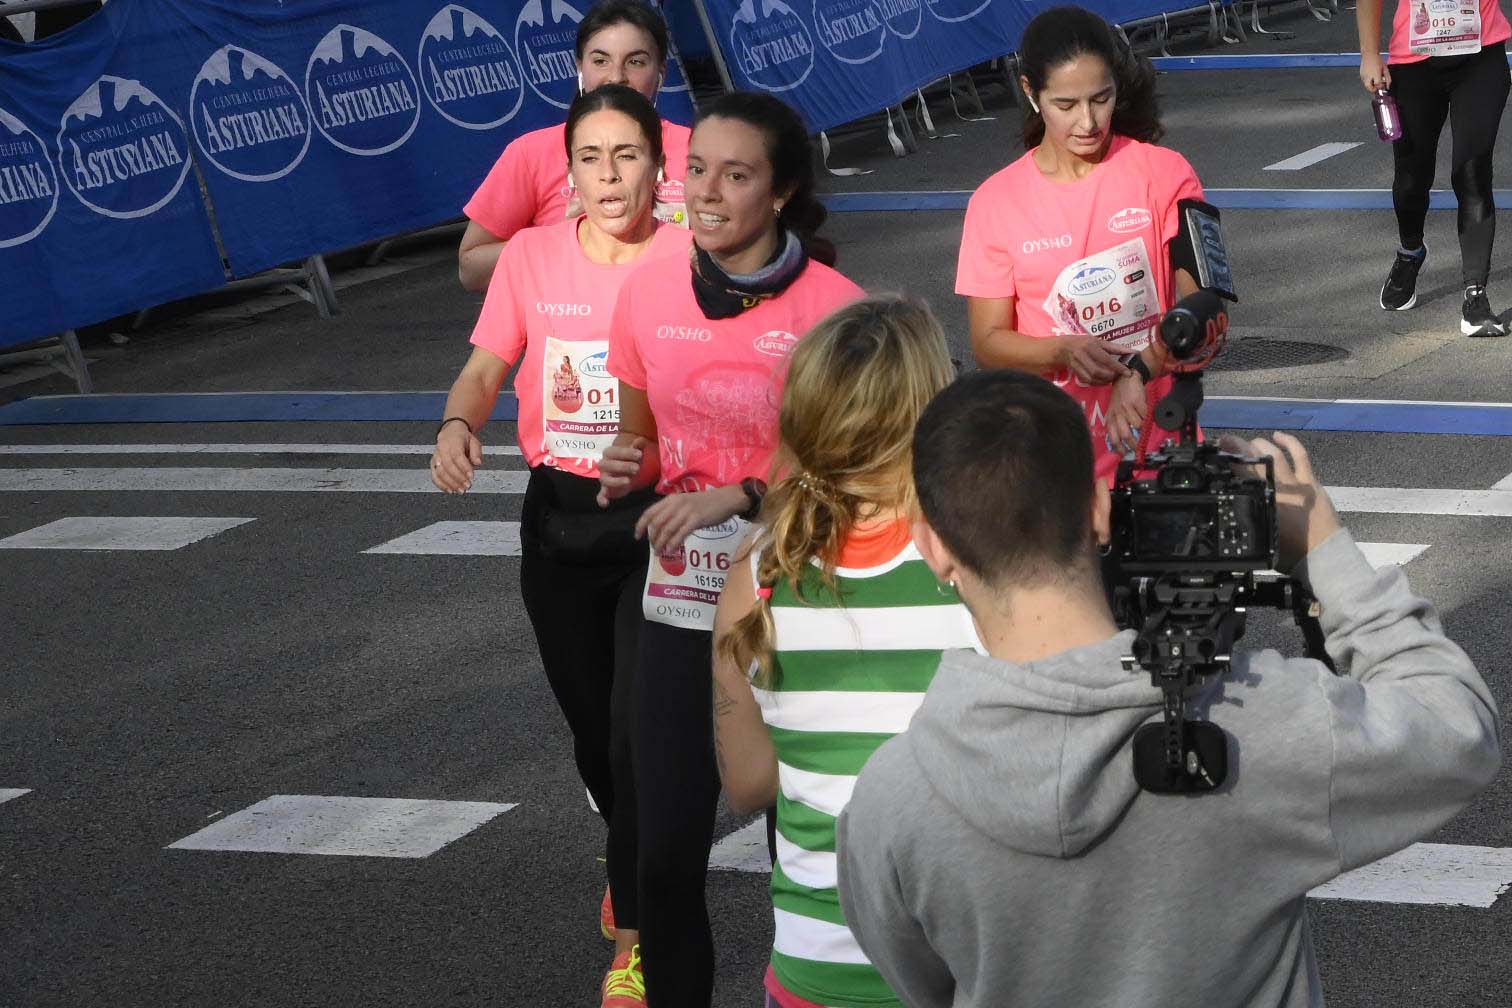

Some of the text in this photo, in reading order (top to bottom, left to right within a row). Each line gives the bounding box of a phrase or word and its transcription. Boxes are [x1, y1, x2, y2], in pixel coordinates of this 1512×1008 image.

[1432, 17, 1456, 28] 016
[428, 55, 520, 104] ASTURIANA
[315, 79, 416, 129] ASTURIANA
[202, 101, 306, 154] ASTURIANA
[1023, 235, 1073, 254] OYSHO
[1072, 273, 1113, 293] ASTURIANA
[536, 301, 592, 317] OYSHO
[1082, 297, 1122, 321] 016
[656, 325, 712, 342] OYSHO
[1091, 318, 1115, 334] 6670
[587, 388, 616, 405] 01
[559, 423, 594, 432] CARRERA
[555, 439, 596, 450] OYSHO
[689, 549, 731, 571] 016
[695, 574, 725, 589] 16159
[664, 588, 699, 599] CARRERA
[657, 604, 701, 619] OYSHO
